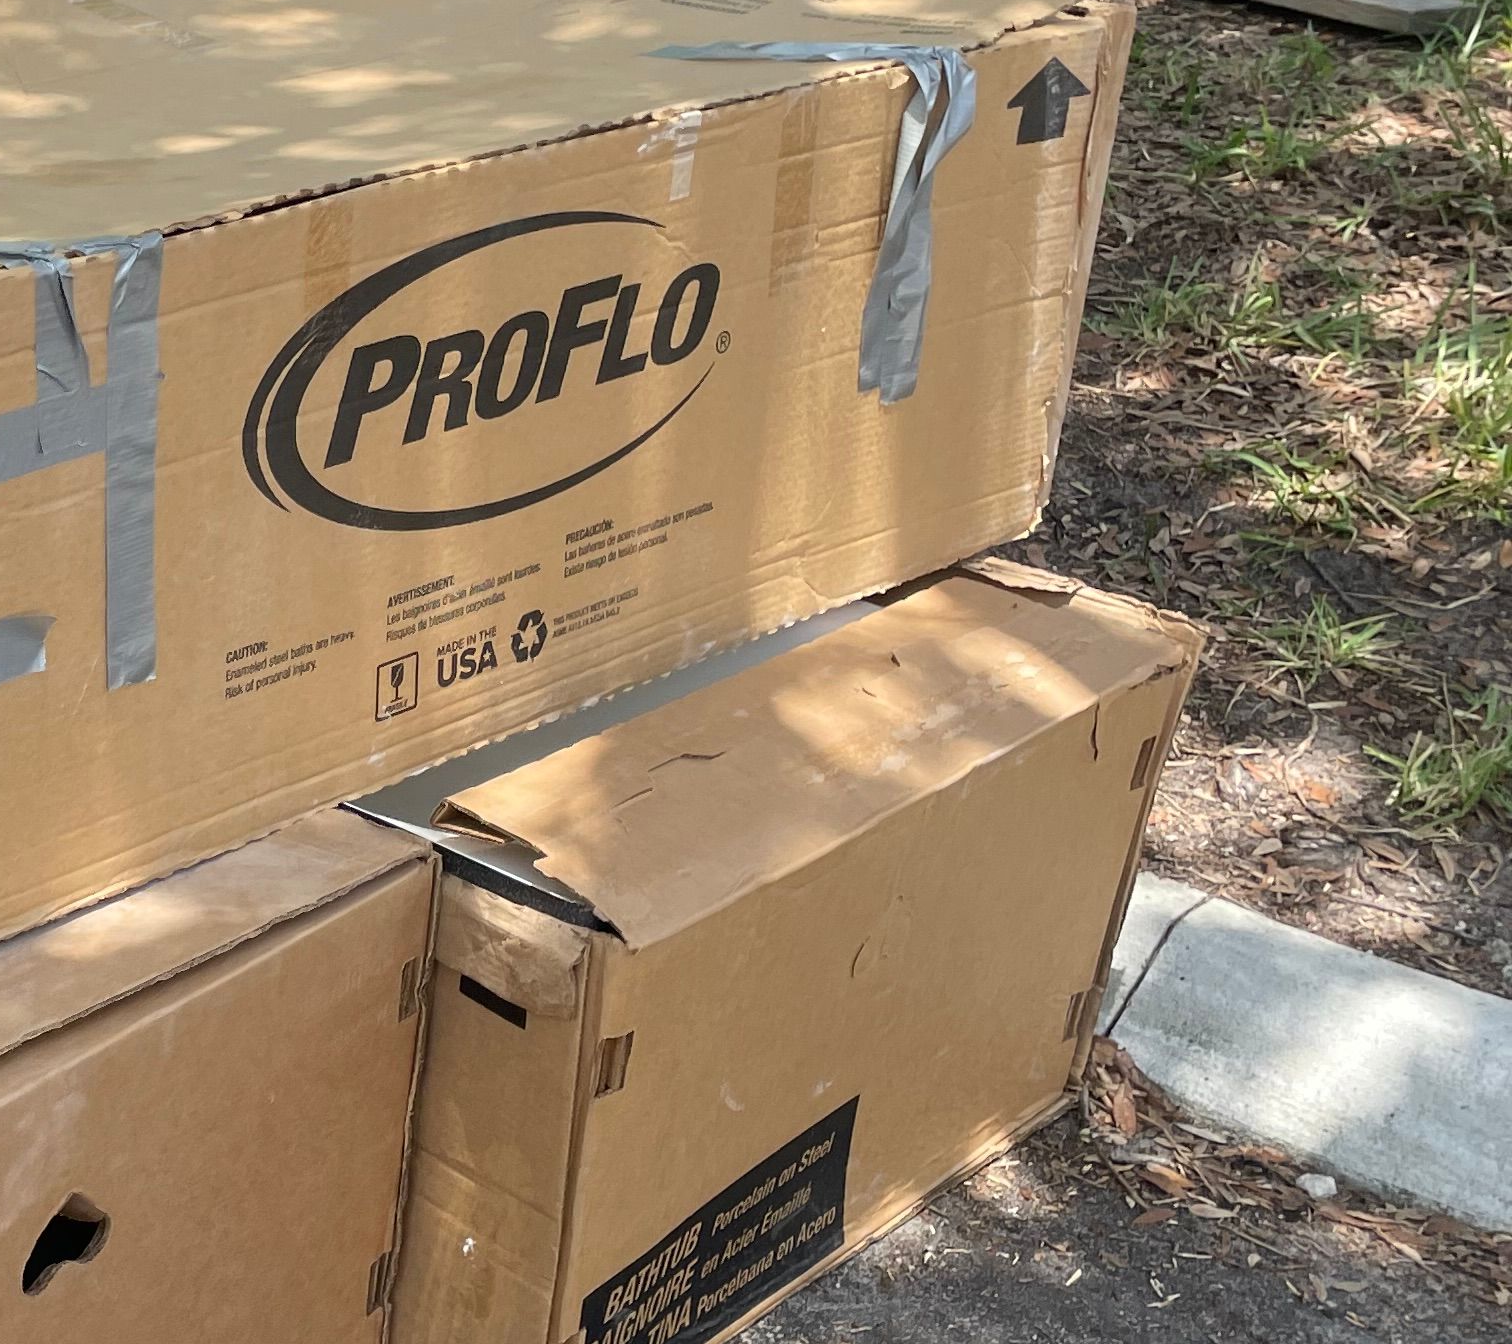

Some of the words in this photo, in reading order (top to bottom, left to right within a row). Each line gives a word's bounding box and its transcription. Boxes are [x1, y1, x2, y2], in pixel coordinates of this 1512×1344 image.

[324, 262, 721, 469] PROFLO
[437, 637, 466, 656] MADE
[466, 634, 477, 646] IN
[479, 626, 496, 642] THE
[438, 640, 498, 688] USA
[603, 1221, 702, 1324] BATHTUB
[712, 1174, 776, 1237] Porcelain
[778, 1162, 796, 1188] on
[798, 1132, 836, 1173] Steel
[696, 1252, 774, 1320] Porcelaana
[776, 1234, 794, 1262] en
[796, 1206, 836, 1248] Acero
[701, 1255, 718, 1280] en
[721, 1222, 758, 1264] Acier
[760, 1181, 813, 1236] Émaillé
